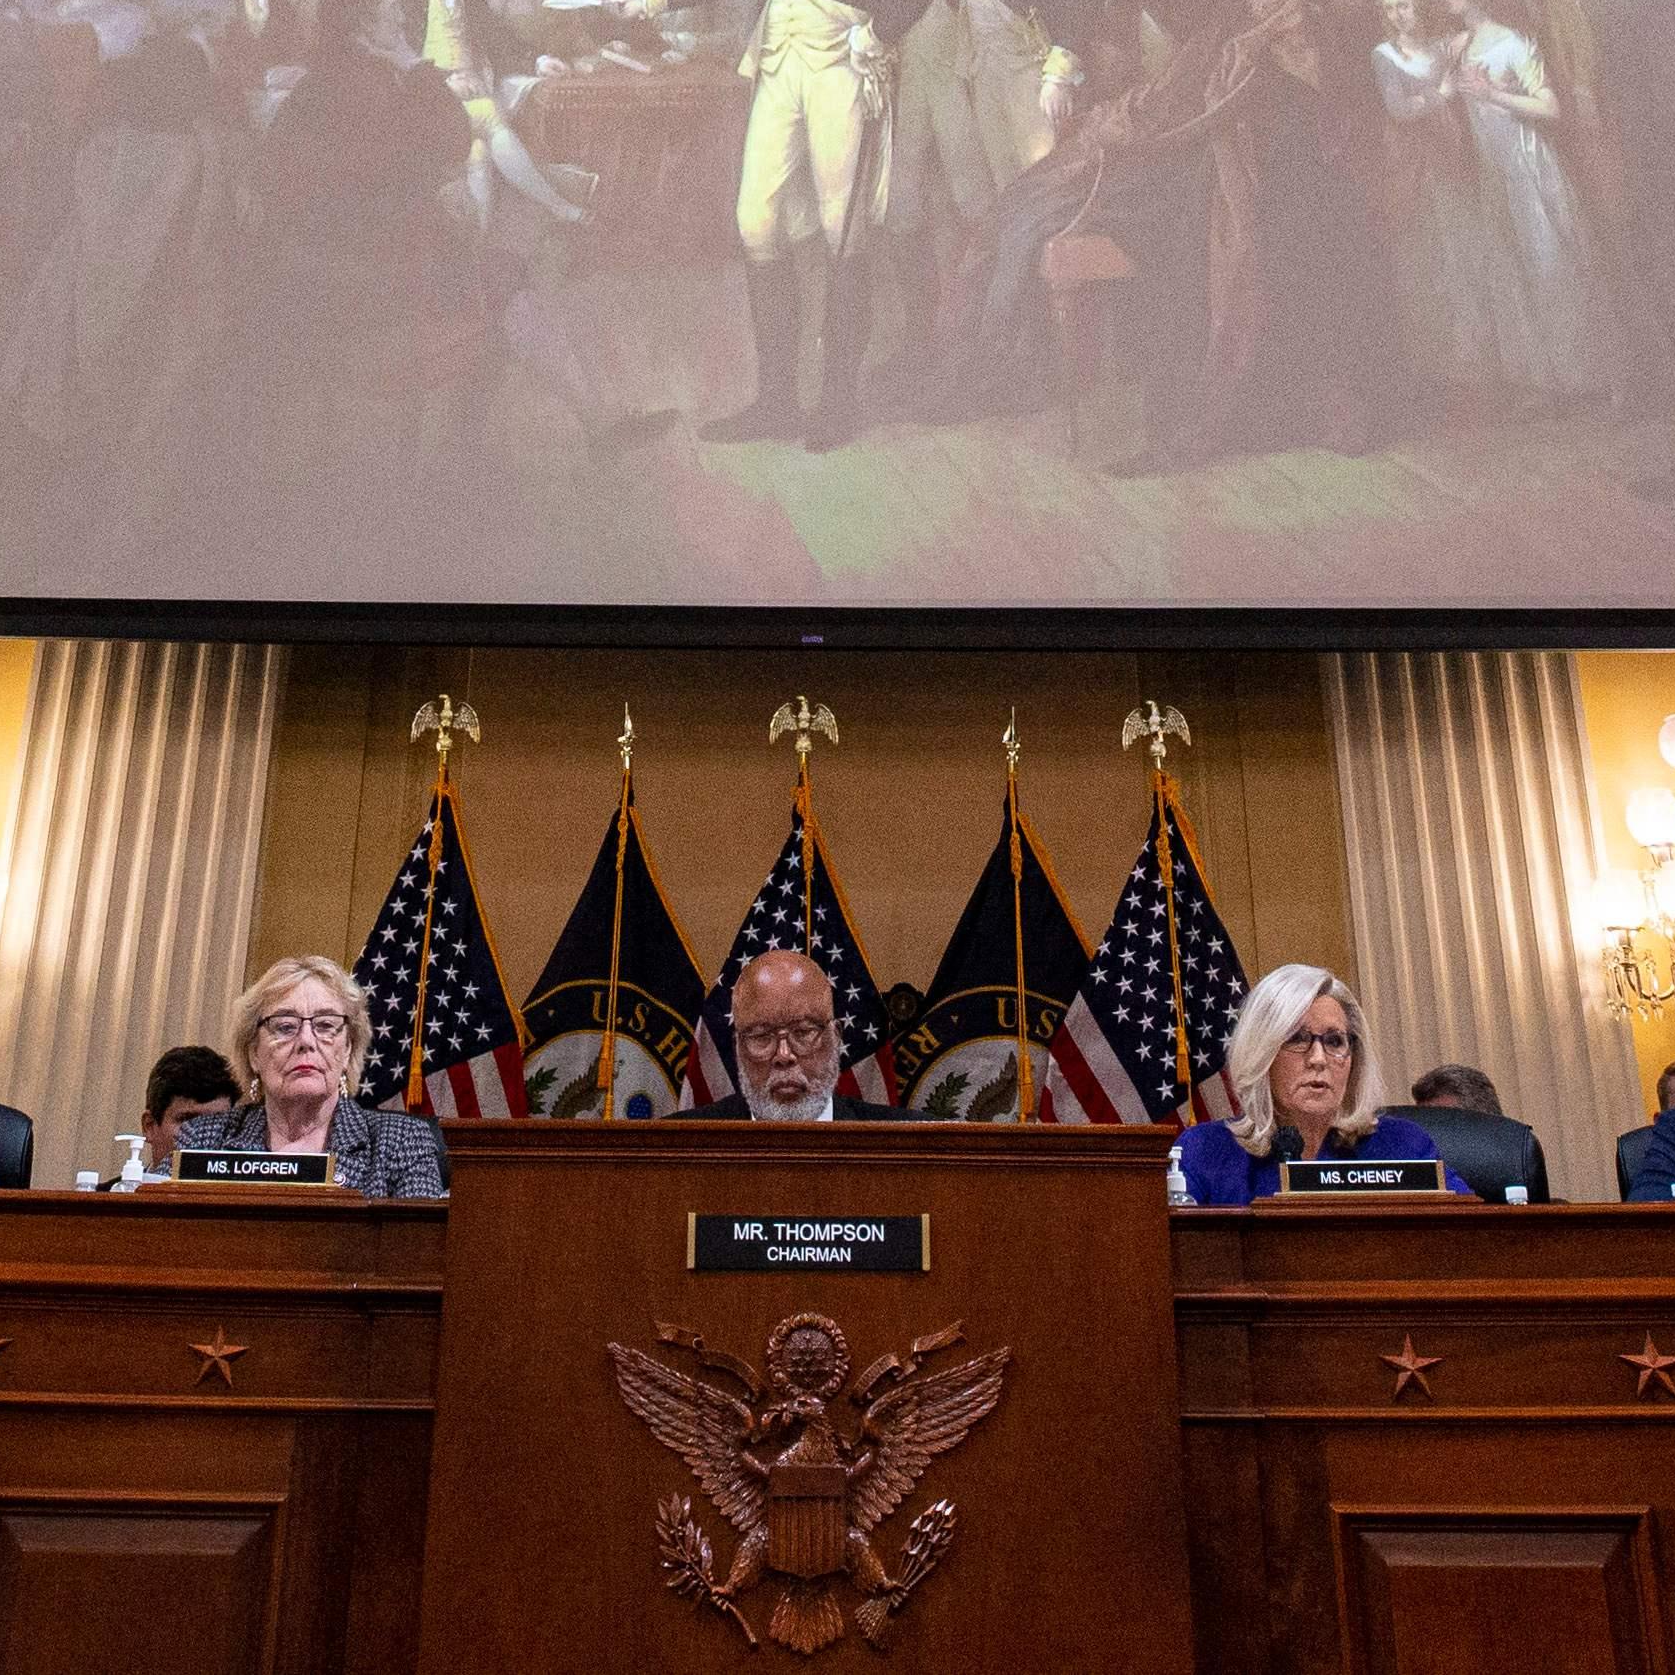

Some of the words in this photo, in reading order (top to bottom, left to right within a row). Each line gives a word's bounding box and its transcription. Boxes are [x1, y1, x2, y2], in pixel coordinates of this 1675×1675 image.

[207, 1160, 231, 1174] MS.
[234, 1161, 298, 1175] LOFGREN
[1320, 1171, 1345, 1184] MS.
[1347, 1170, 1404, 1184] CHENEY
[733, 1223, 769, 1241] MR.
[773, 1223, 886, 1242] THOMPSON
[766, 1246, 852, 1263] CHAIRMAN
